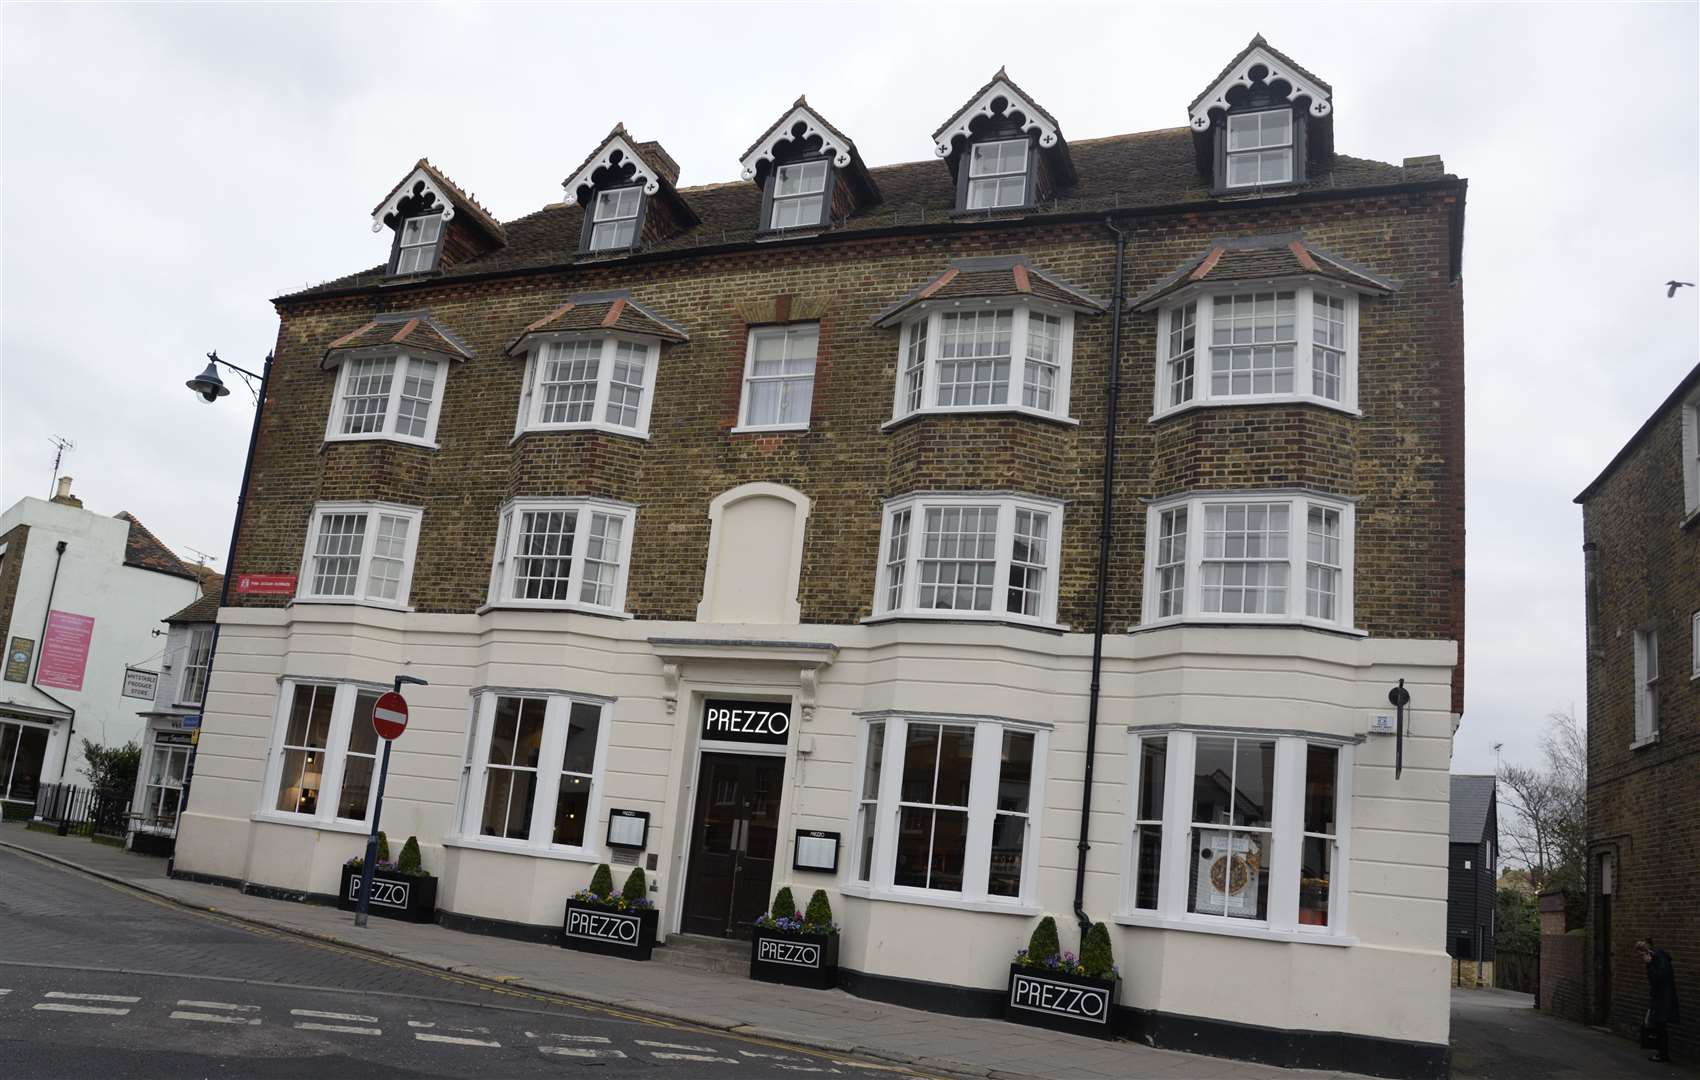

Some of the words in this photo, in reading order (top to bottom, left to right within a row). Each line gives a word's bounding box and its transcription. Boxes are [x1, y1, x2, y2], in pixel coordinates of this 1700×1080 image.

[706, 708, 789, 735] PREZZO
[352, 879, 406, 904] PEZZO
[570, 912, 636, 940] PREZZO
[761, 941, 817, 963] PREZZO
[1016, 980, 1103, 1016] PREZZO
